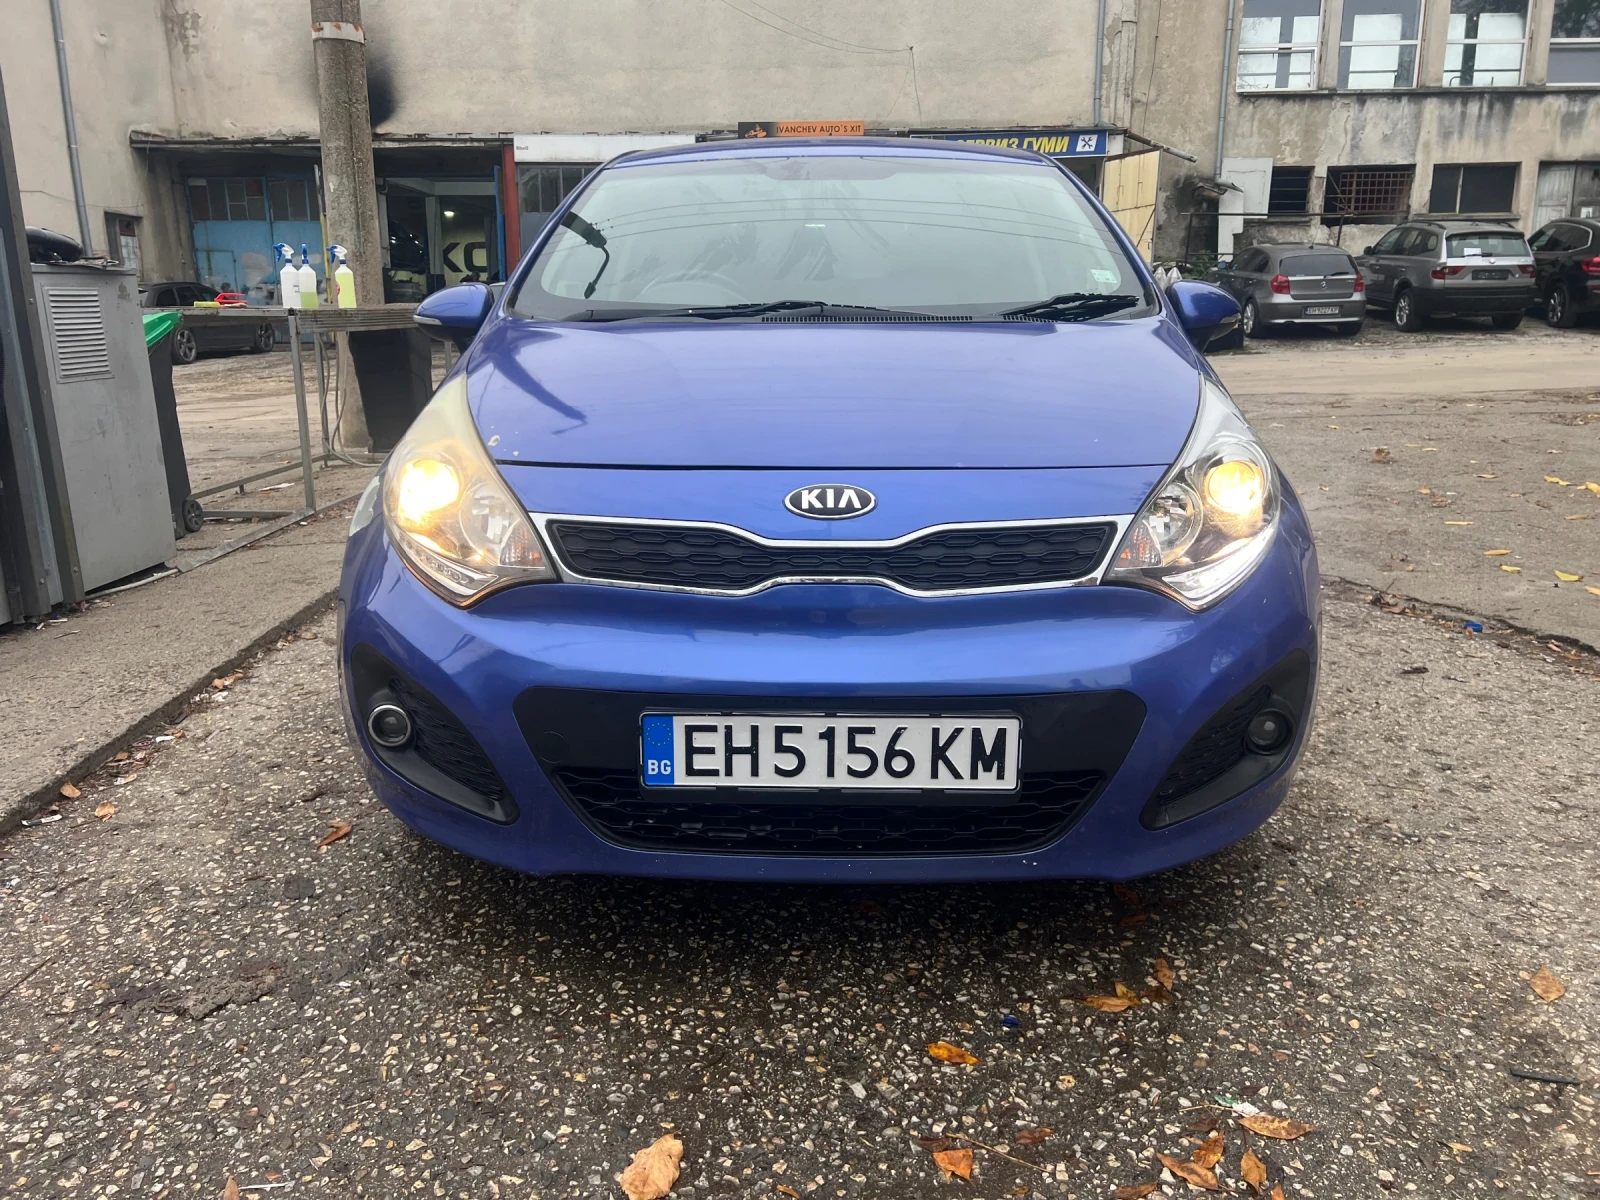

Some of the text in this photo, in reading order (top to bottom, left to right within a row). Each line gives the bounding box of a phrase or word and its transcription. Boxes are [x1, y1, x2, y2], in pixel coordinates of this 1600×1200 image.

[776, 125, 817, 133] IVANCHEV
[850, 124, 862, 133] XIT
[1022, 136, 1070, 153] ГУМИ
[800, 488, 862, 510] KIA
[647, 759, 671, 775] BG
